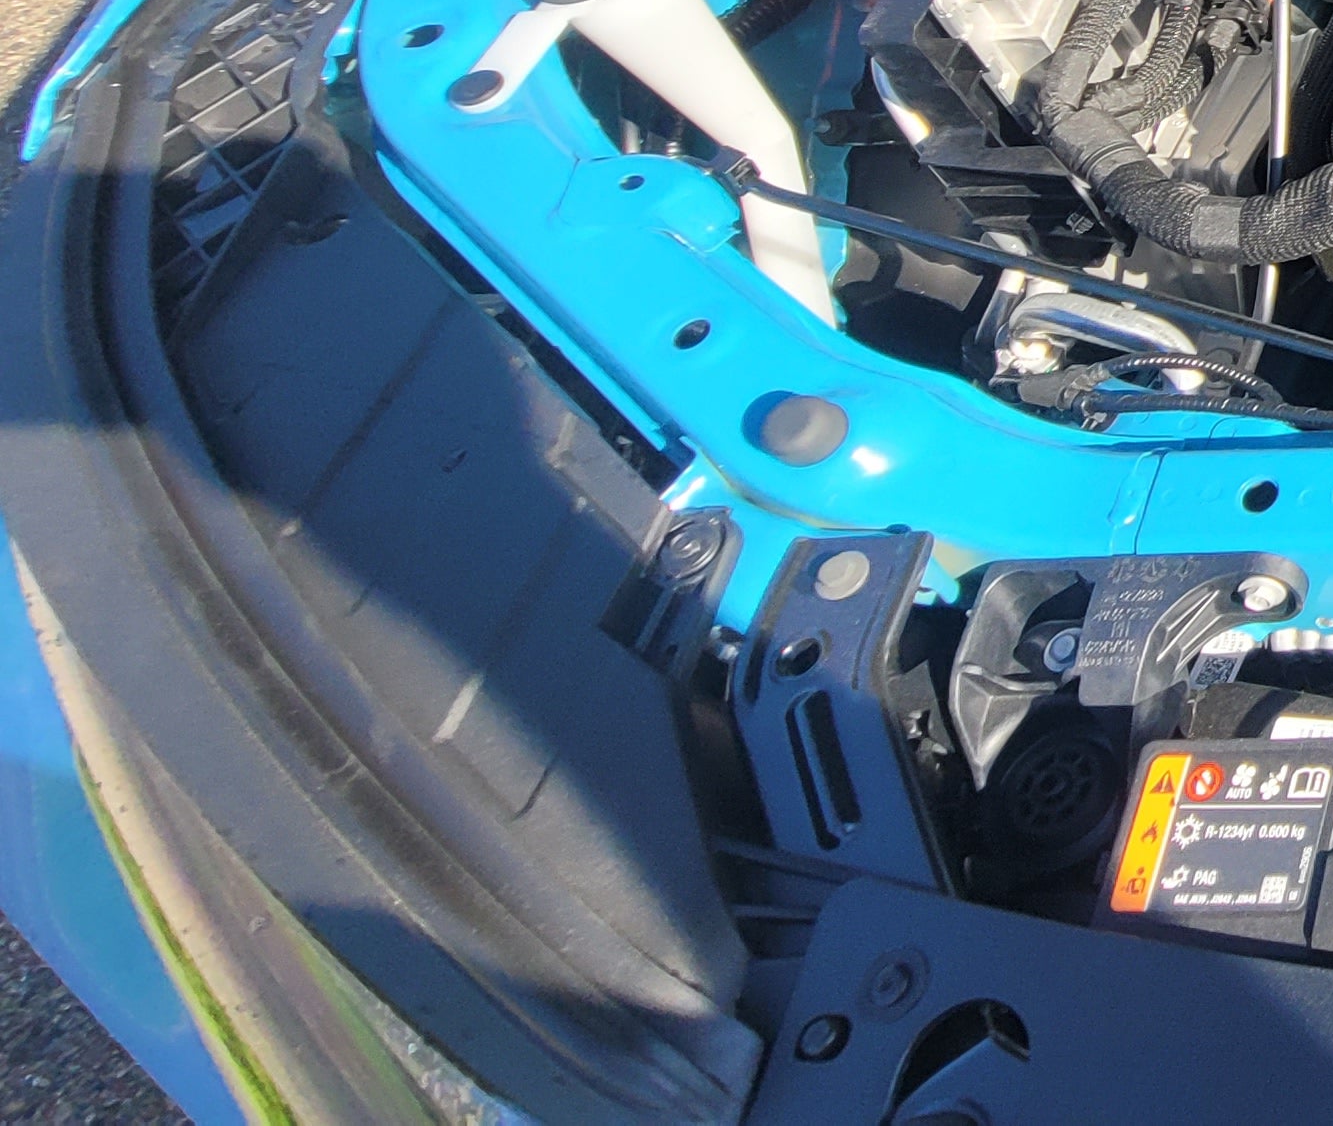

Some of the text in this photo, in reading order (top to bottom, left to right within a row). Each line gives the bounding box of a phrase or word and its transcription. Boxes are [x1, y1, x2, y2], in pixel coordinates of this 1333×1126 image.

[1225, 788, 1252, 800] AUTO
[1204, 824, 1306, 841] R-1234yf 0.600 kg
[1192, 870, 1218, 886] PAG
